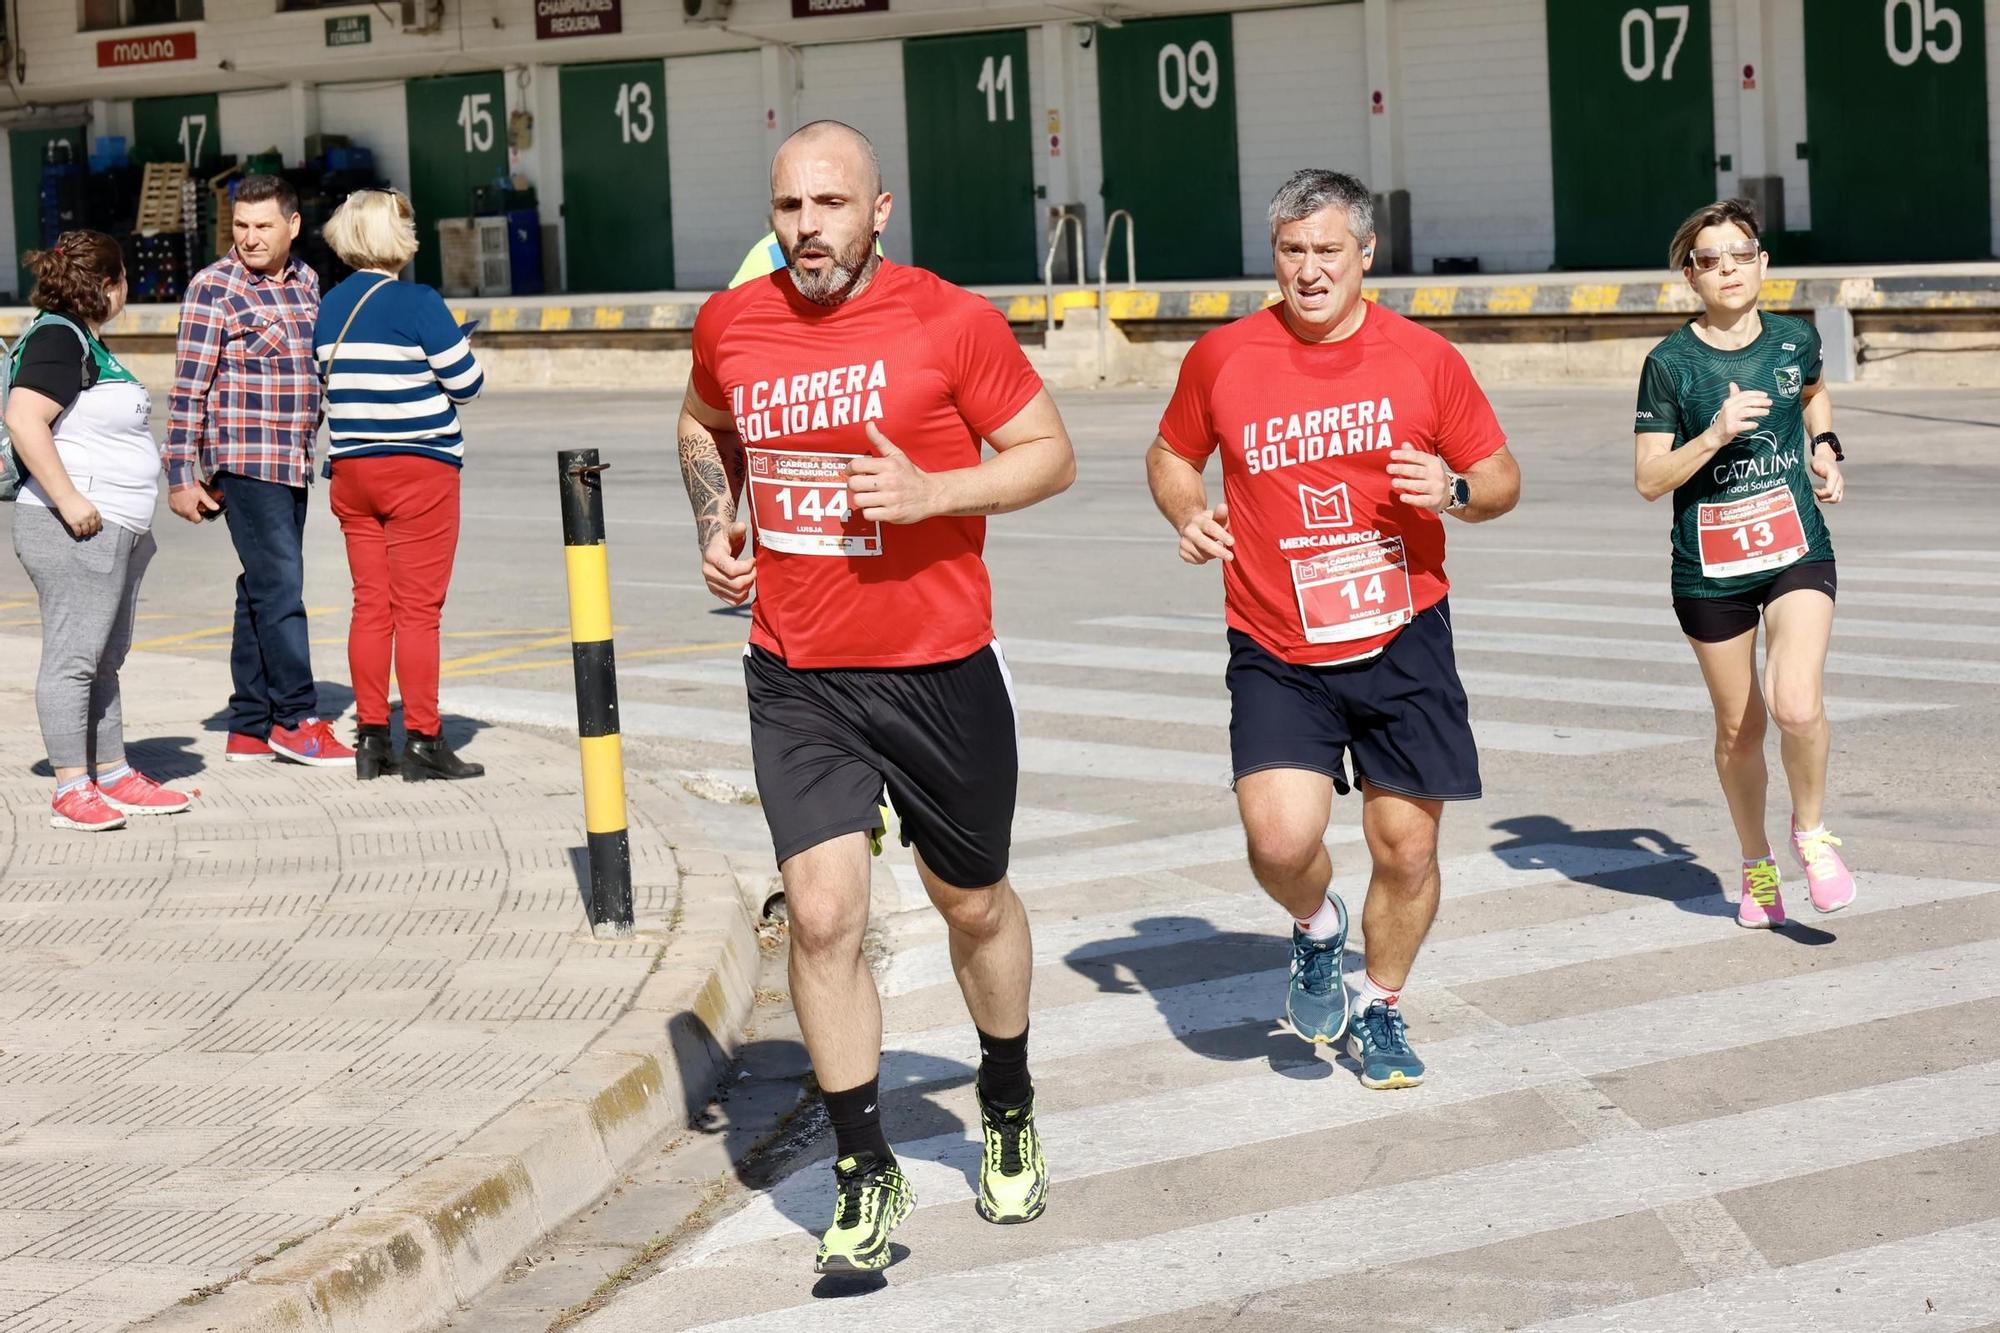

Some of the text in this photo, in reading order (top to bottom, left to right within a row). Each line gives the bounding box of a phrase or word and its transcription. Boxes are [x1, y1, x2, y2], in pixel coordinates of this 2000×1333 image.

[550, 15, 601, 32] REQUENA
[1620, 5, 1690, 82] 07
[1885, 0, 1963, 66] 05
[976, 54, 1014, 122] 11
[1158, 40, 1219, 111] 09
[457, 93, 494, 153] 15
[614, 81, 655, 143] 13
[178, 114, 208, 168] 17
[733, 359, 887, 416] II CARRERA
[736, 390, 884, 444] SOLIDARIA
[1243, 396, 1394, 450] II CARRERA
[776, 467, 840, 478] MERCAMURCIA
[780, 460, 820, 470] CARRERA
[821, 461, 847, 471] SOLID
[1245, 423, 1393, 475] SOLIDARIA
[1713, 449, 1800, 485] CATALINA
[775, 487, 852, 523] 144
[1726, 476, 1787, 495] Food Solutions
[1279, 529, 1382, 550] MERCAMURCIA
[1732, 521, 1775, 551] 13
[1340, 574, 1386, 610] 14
